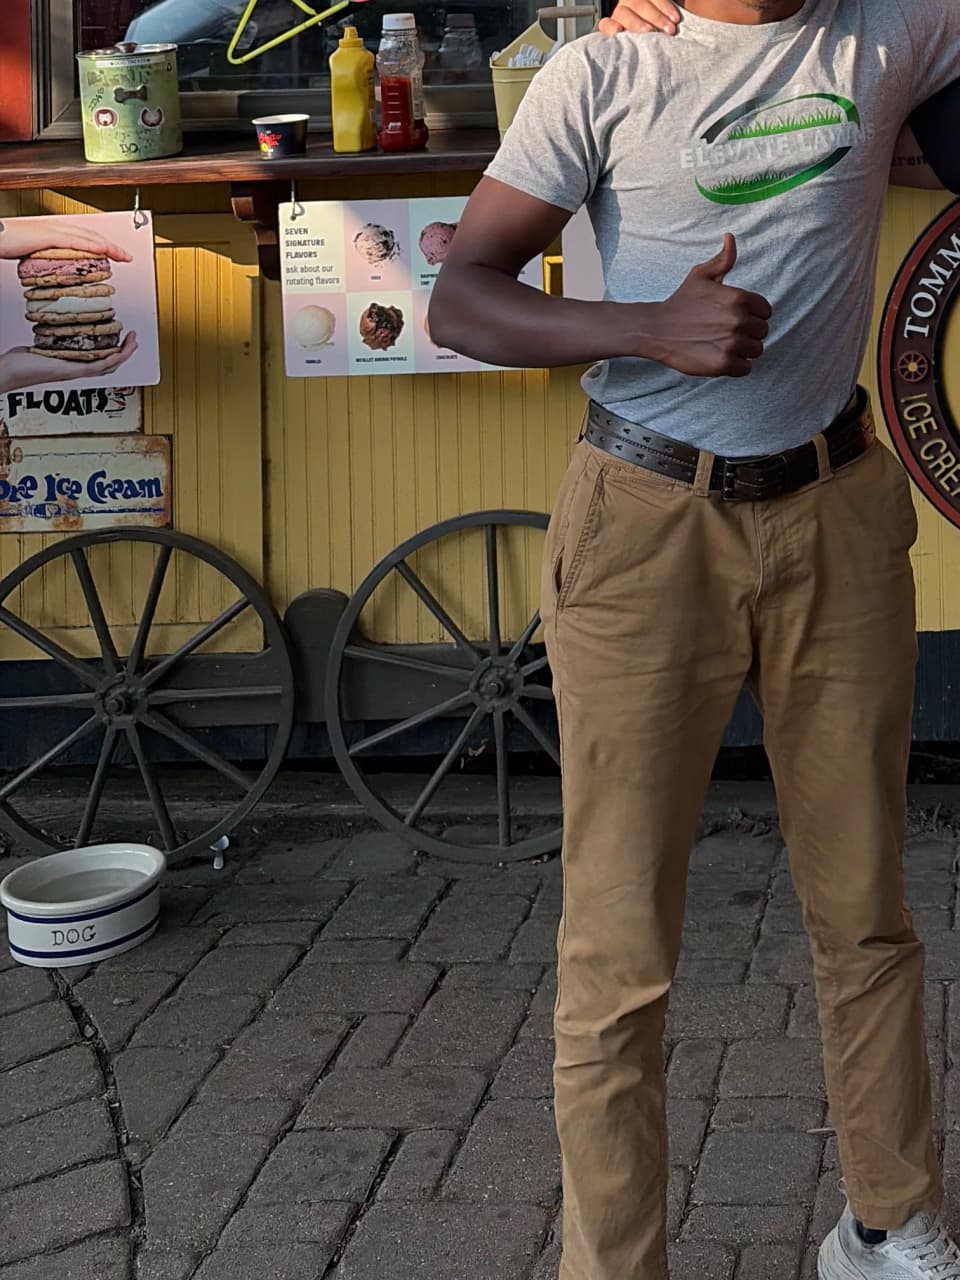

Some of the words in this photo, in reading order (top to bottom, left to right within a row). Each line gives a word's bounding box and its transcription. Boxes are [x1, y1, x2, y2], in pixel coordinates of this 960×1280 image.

[285, 228, 308, 236] SEVEN
[285, 239, 325, 247] SIGNATURE
[286, 251, 317, 259] FLAVORS
[286, 266, 298, 274] ask
[300, 265, 320, 273] about
[286, 277, 314, 286] rotating
[315, 276, 340, 284] flavors
[901, 393, 938, 440] ICE
[44, 473, 82, 502] Ice
[87, 470, 163, 504] Cream
[51, 925, 97, 946] DOG
